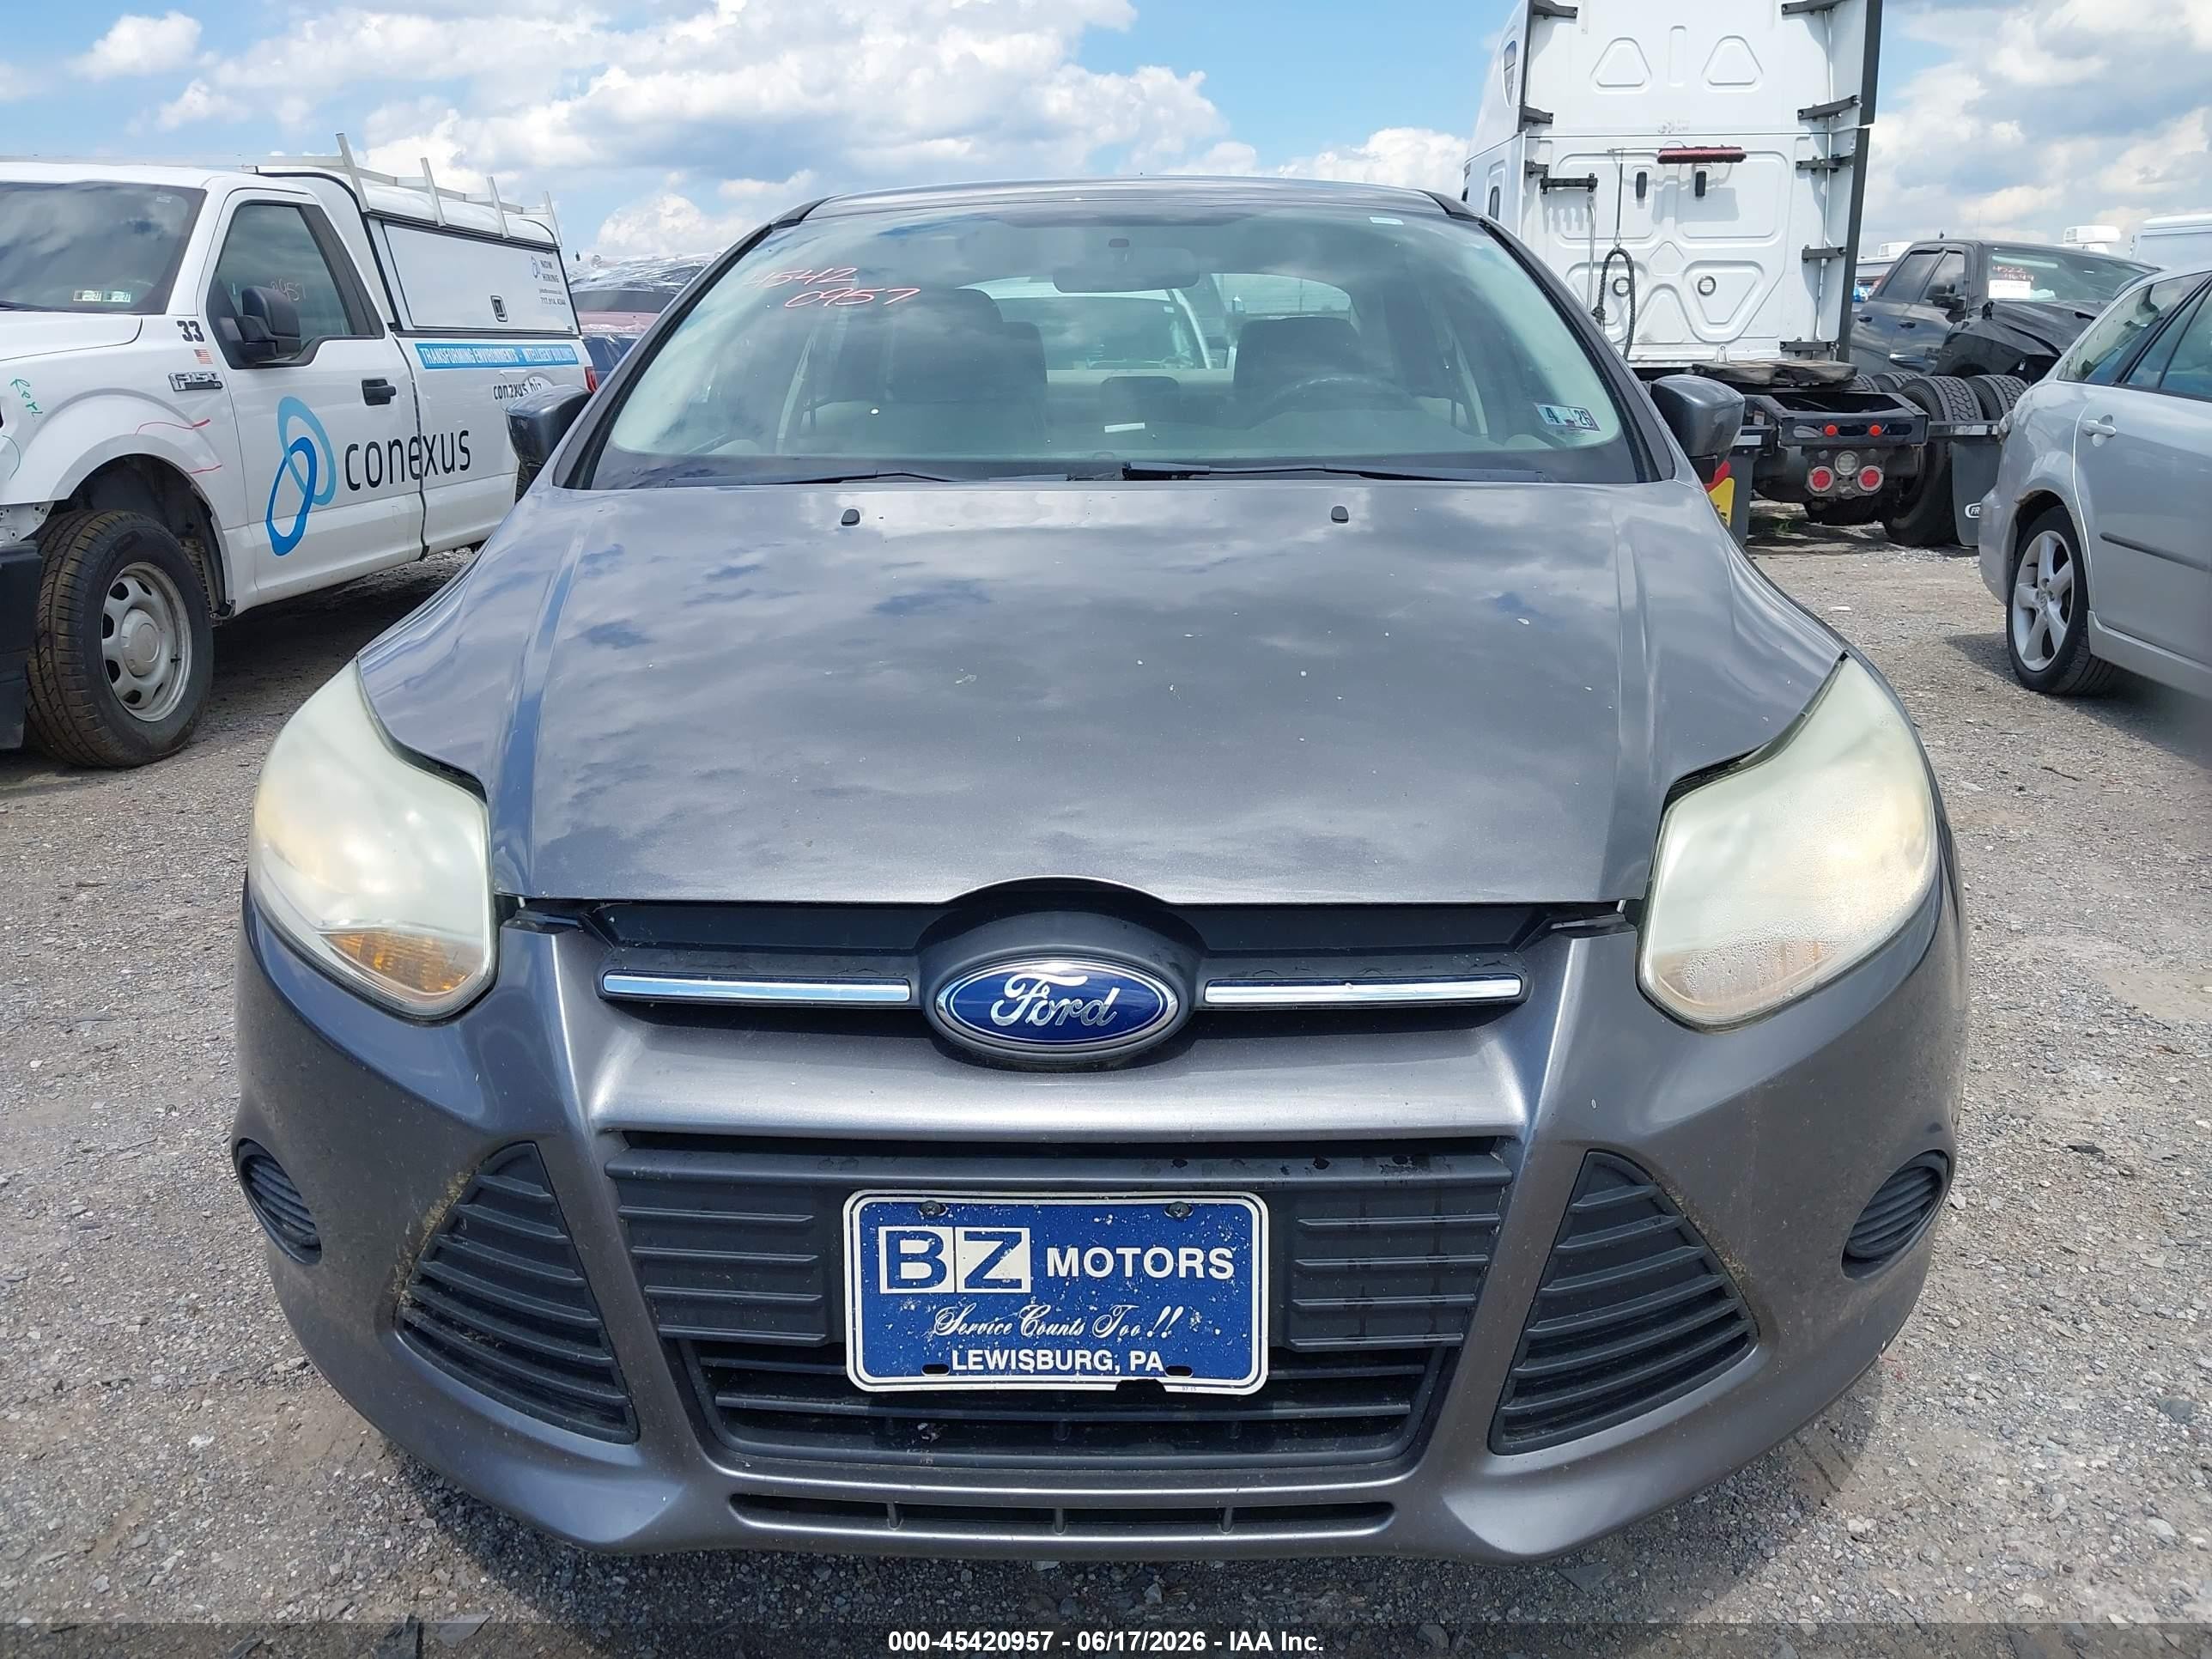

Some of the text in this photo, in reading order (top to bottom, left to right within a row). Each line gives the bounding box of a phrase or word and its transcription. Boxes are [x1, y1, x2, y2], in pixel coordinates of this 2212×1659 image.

[744, 268, 858, 289] 4542
[785, 288, 921, 308] 0957
[176, 320, 205, 343] 33
[1545, 407, 1594, 426] 4 26
[344, 430, 471, 491] conexus
[990, 973, 1121, 1027] Ford
[885, 1231, 1235, 1290] BZ MOTORS
[933, 1303, 1012, 1337] Service
[1017, 1304, 1087, 1338] Counts
[951, 1348, 1164, 1375] LEWISBURG, PA
